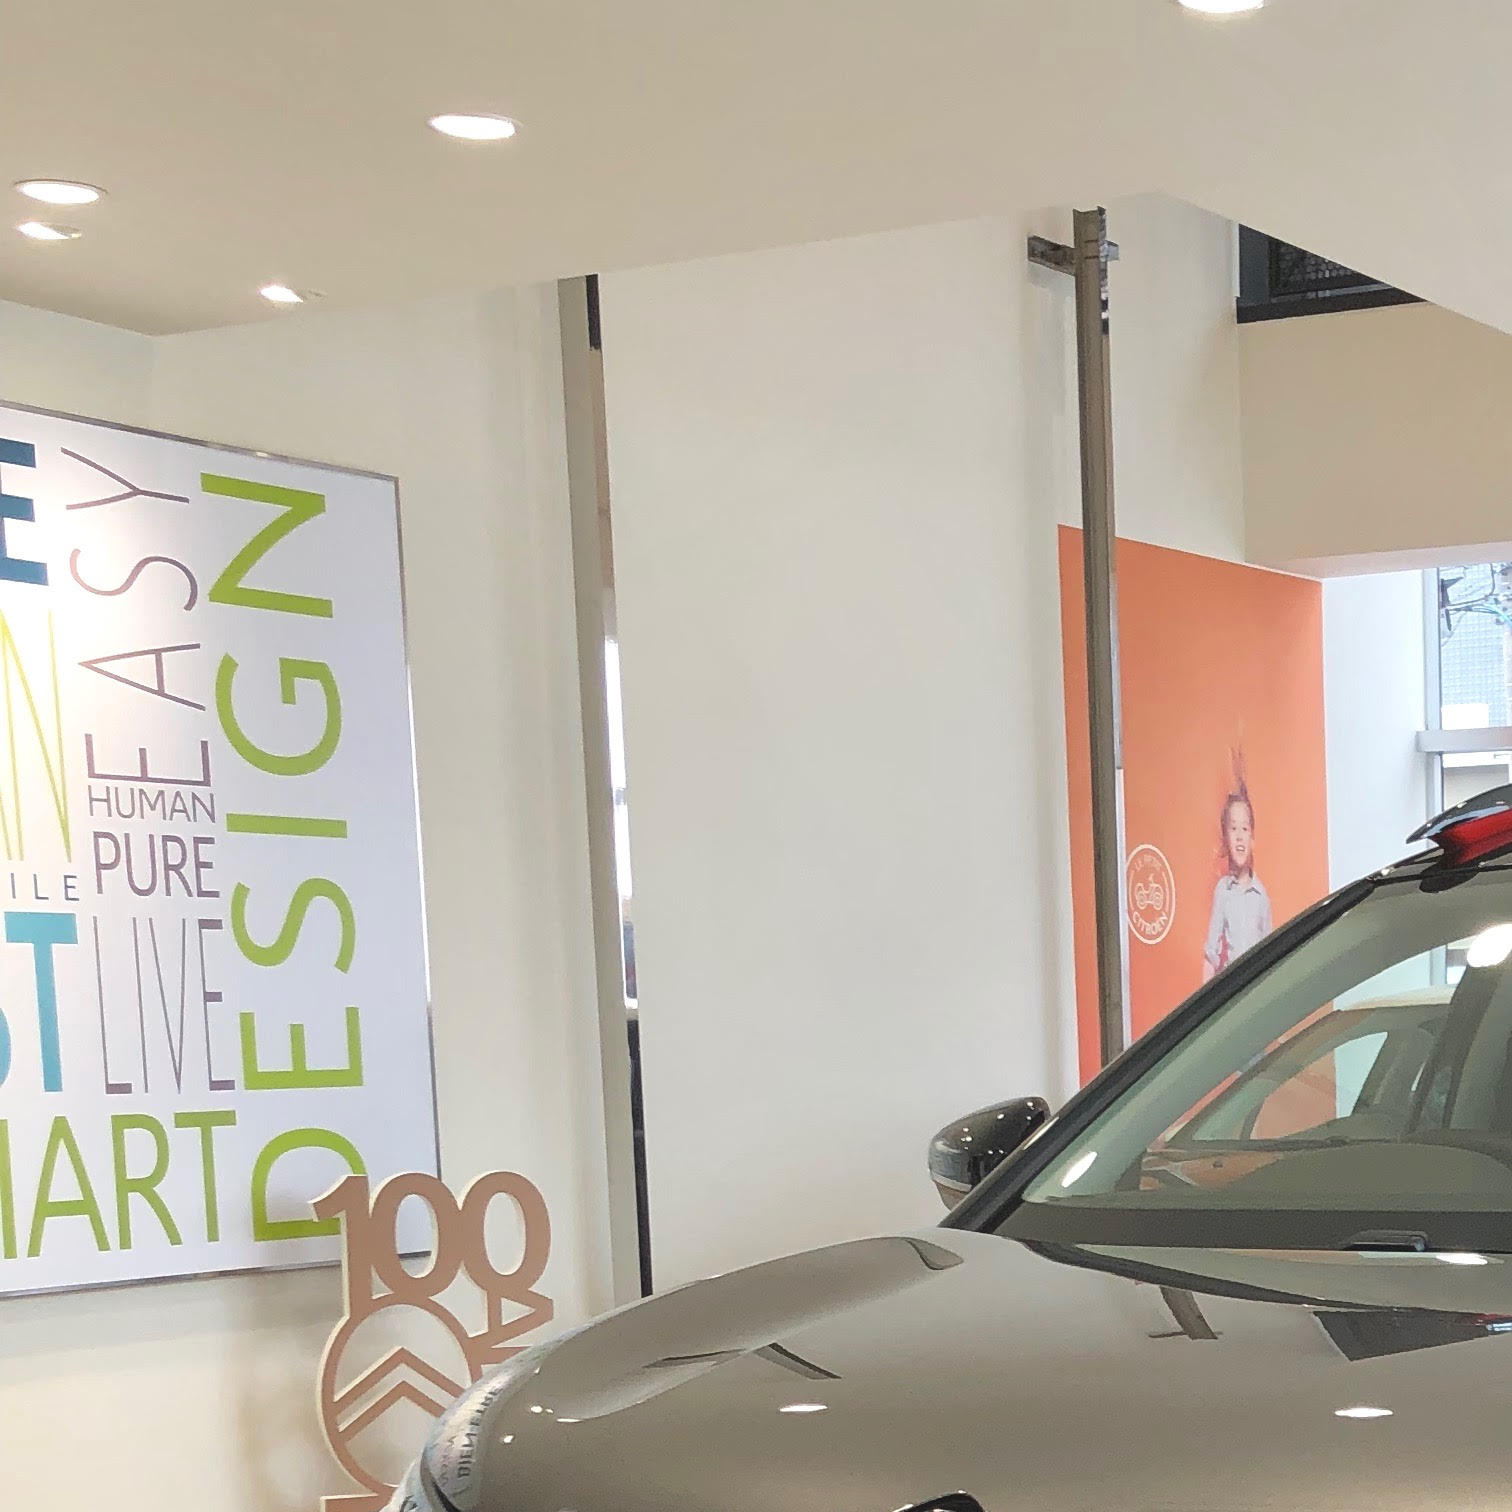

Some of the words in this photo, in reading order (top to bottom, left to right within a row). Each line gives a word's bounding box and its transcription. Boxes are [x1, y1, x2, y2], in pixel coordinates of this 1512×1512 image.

[61, 446, 211, 787] EASY
[88, 785, 216, 823] HUMAN
[93, 831, 220, 898] PURE
[200, 472, 368, 1242] DESIGN
[93, 915, 235, 1095] LIVE
[308, 1170, 551, 1300] 100
